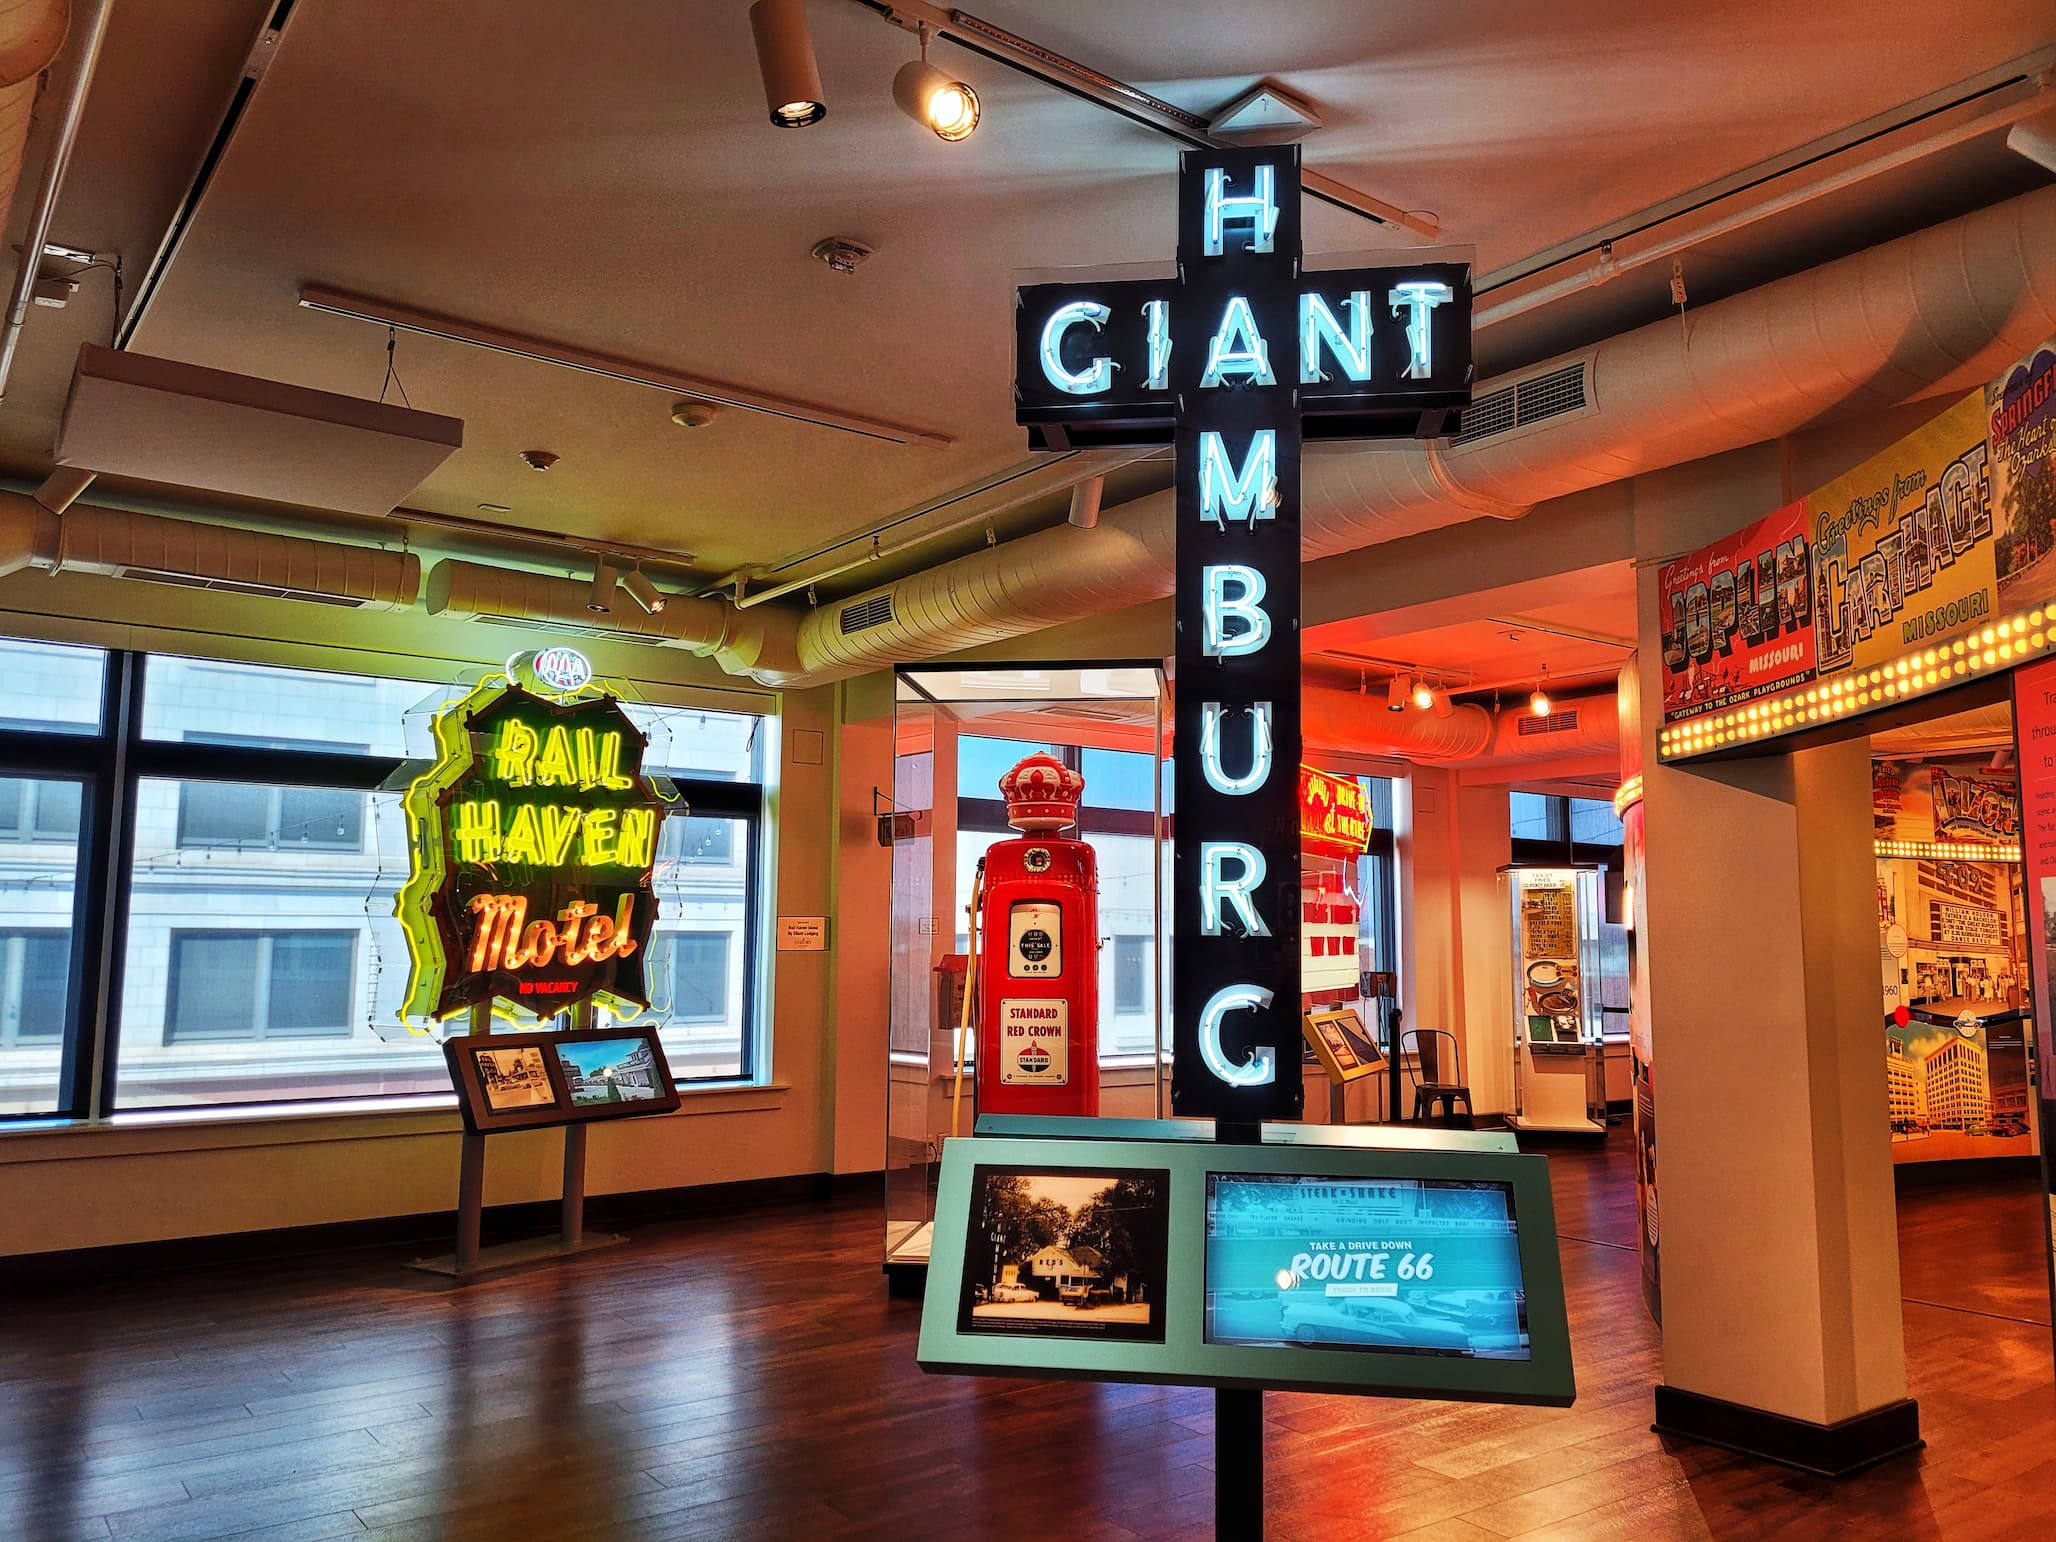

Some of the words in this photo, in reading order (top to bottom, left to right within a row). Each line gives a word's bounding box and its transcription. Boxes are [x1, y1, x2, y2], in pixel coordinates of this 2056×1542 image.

[1040, 283, 1454, 395] GIANT
[1997, 440, 2016, 463] The
[2017, 416, 2048, 451] Heart
[2011, 442, 2056, 482] Ozarks
[1816, 487, 1890, 555] Greetings
[1889, 469, 1927, 525] from
[1664, 564, 1704, 591] Greetings
[1707, 552, 1730, 575] from
[1811, 440, 1993, 675] CARTHAGE
[1663, 535, 1811, 672] JOPLIN
[1903, 588, 1989, 645] MISSOURI
[541, 649, 588, 687] AAA
[1749, 642, 1804, 674] MISSOURI
[1705, 702, 1713, 710] TO
[1715, 698, 1727, 708] THE
[1729, 690, 1751, 704] OZARK
[496, 718, 633, 793] RAIL
[2043, 755, 2054, 768] to
[456, 800, 655, 868] HAVEN
[466, 893, 638, 973] Motel
[519, 982, 534, 995] NO
[535, 981, 579, 994] VACANCY
[1007, 1026, 1028, 1037] RED
[1029, 1025, 1062, 1037] CROWN
[1010, 1008, 1058, 1019] STANDARD
[1019, 1056, 1049, 1064] STANDARD
[1300, 1187, 1337, 1199] STEAK
[1351, 1187, 1396, 1200] SHAKE
[1310, 1241, 1337, 1250] TAKE
[1338, 1241, 1346, 1250] A
[1348, 1241, 1378, 1250] DRIVE
[1381, 1240, 1413, 1250] DOWN
[1290, 1253, 1390, 1281] ROUTE
[1396, 1253, 1434, 1281] 66
